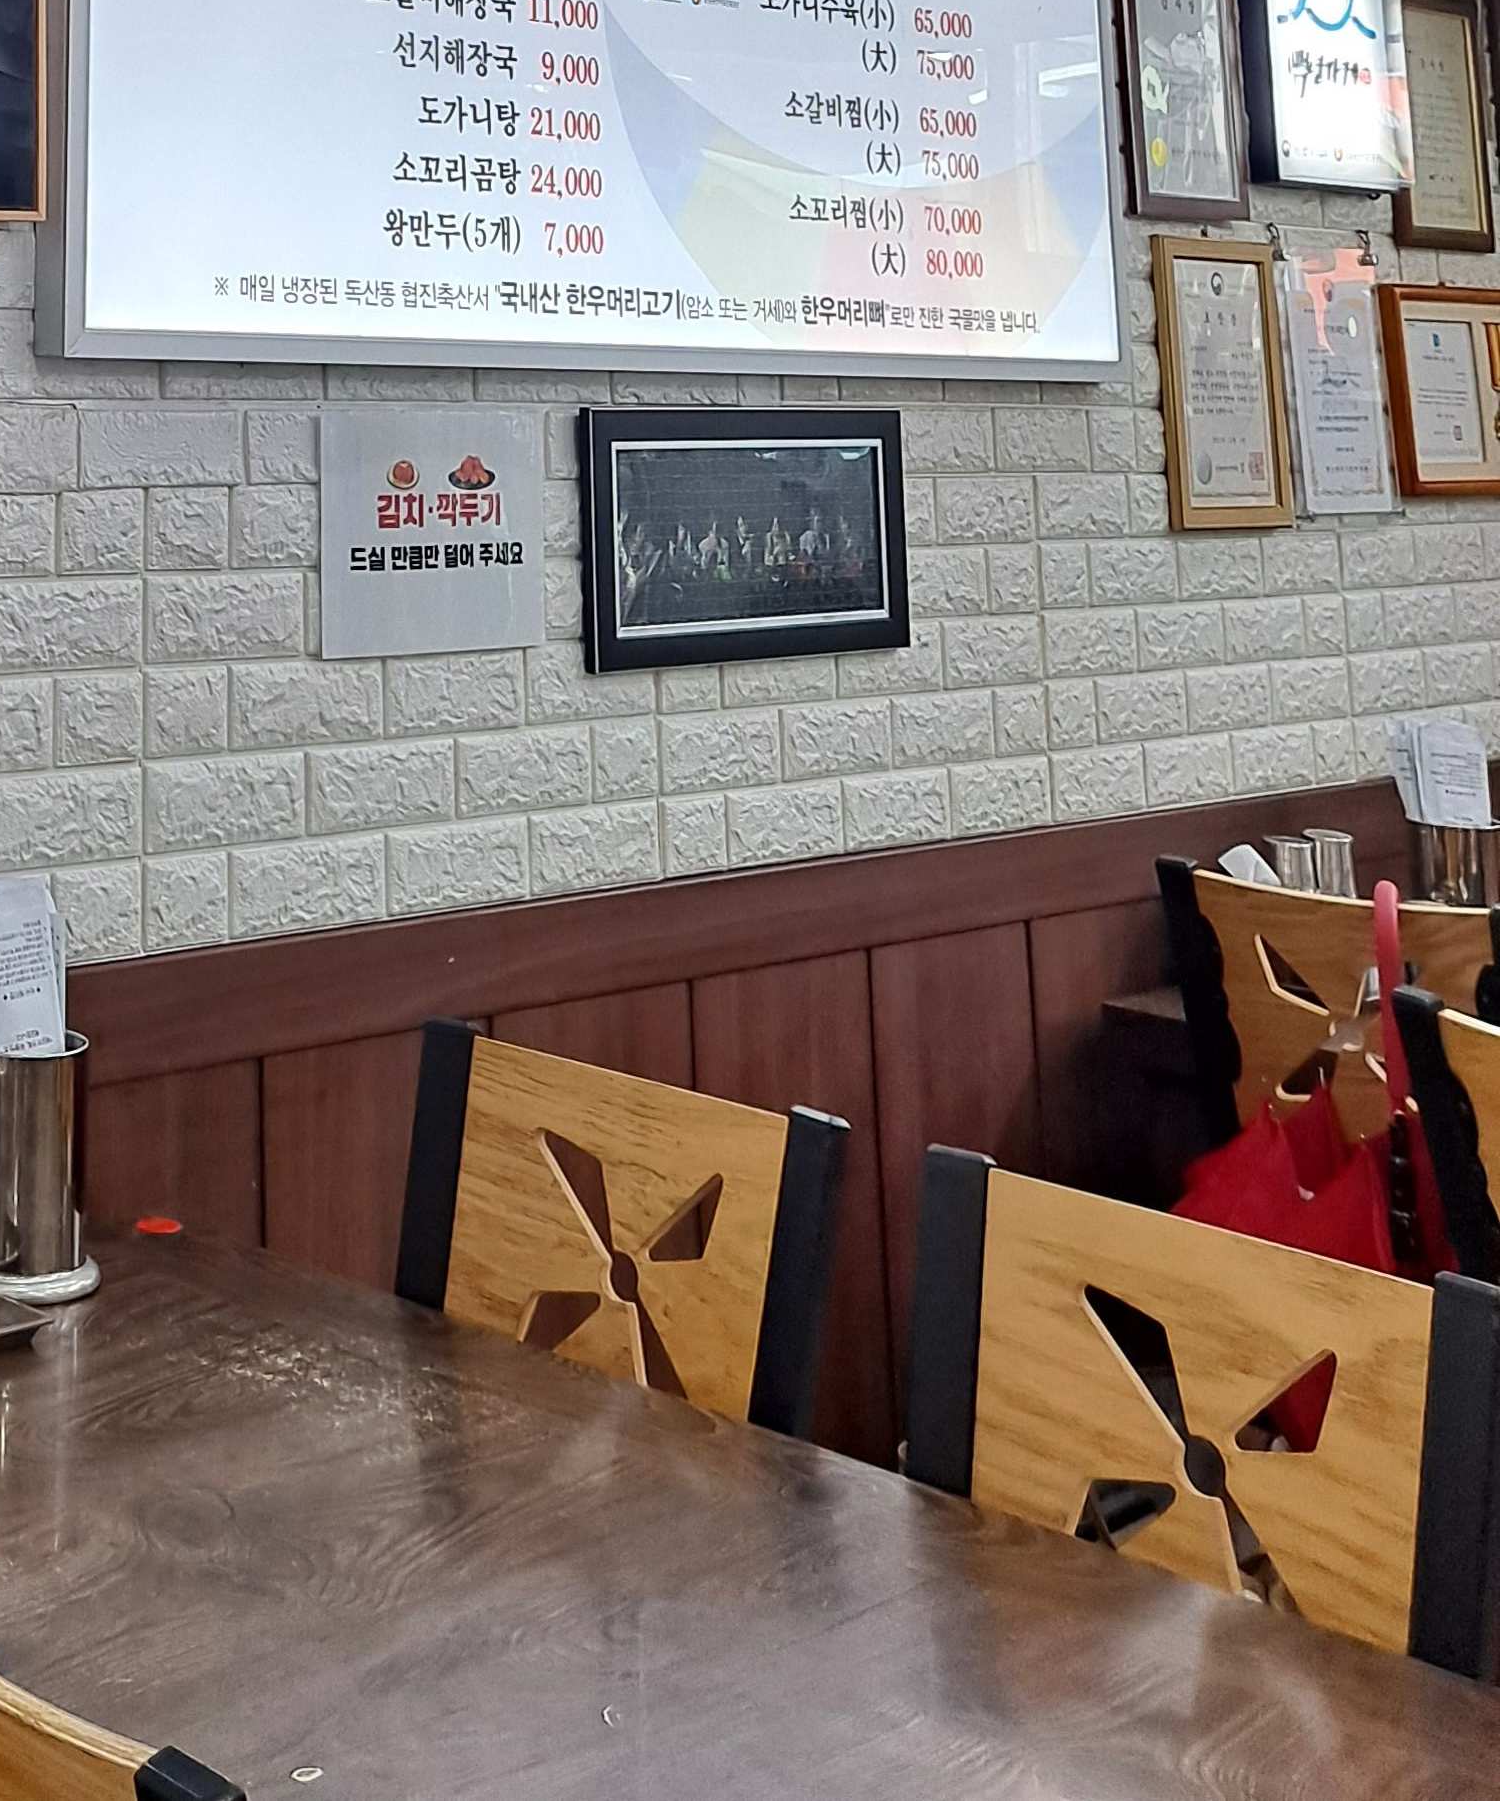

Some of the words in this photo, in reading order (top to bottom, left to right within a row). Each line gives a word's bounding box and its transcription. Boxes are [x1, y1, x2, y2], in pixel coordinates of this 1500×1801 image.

[914, 7, 972, 39] 65,000
[392, 31, 518, 80] 선지해장국
[541, 50, 600, 85] 9,000
[862, 38, 897, 75] (大)
[916, 49, 975, 81] 75,000
[418, 95, 521, 138] 도가니탕
[530, 106, 601, 142] 21,000
[784, 90, 901, 134] 소갈비찜(小)
[919, 106, 978, 138] 65,000
[392, 151, 522, 196] 소꼬리곰탕
[530, 163, 602, 200] 24,000
[866, 140, 902, 176] (大)
[921, 149, 979, 181] 75,000
[383, 208, 522, 255] 왕만두(5개)
[544, 221, 604, 258] 7,000
[789, 193, 904, 233] 소꼬리찜(小)
[923, 205, 982, 236] 70,000
[871, 242, 906, 278] (大)
[925, 248, 984, 279] 80,000
[239, 274, 276, 302] 매일
[281, 276, 338, 305] 냉장된
[344, 278, 396, 308] 독산동
[401, 280, 490, 311] 협진축산서
[718, 298, 748, 322] 또는
[919, 305, 944, 330] 진한
[948, 307, 997, 334] 국물맛을
[350, 545, 386, 572] 드실
[391, 544, 440, 570] 만큼만
[444, 543, 474, 568] 덜어
[479, 541, 524, 567] 주세요
